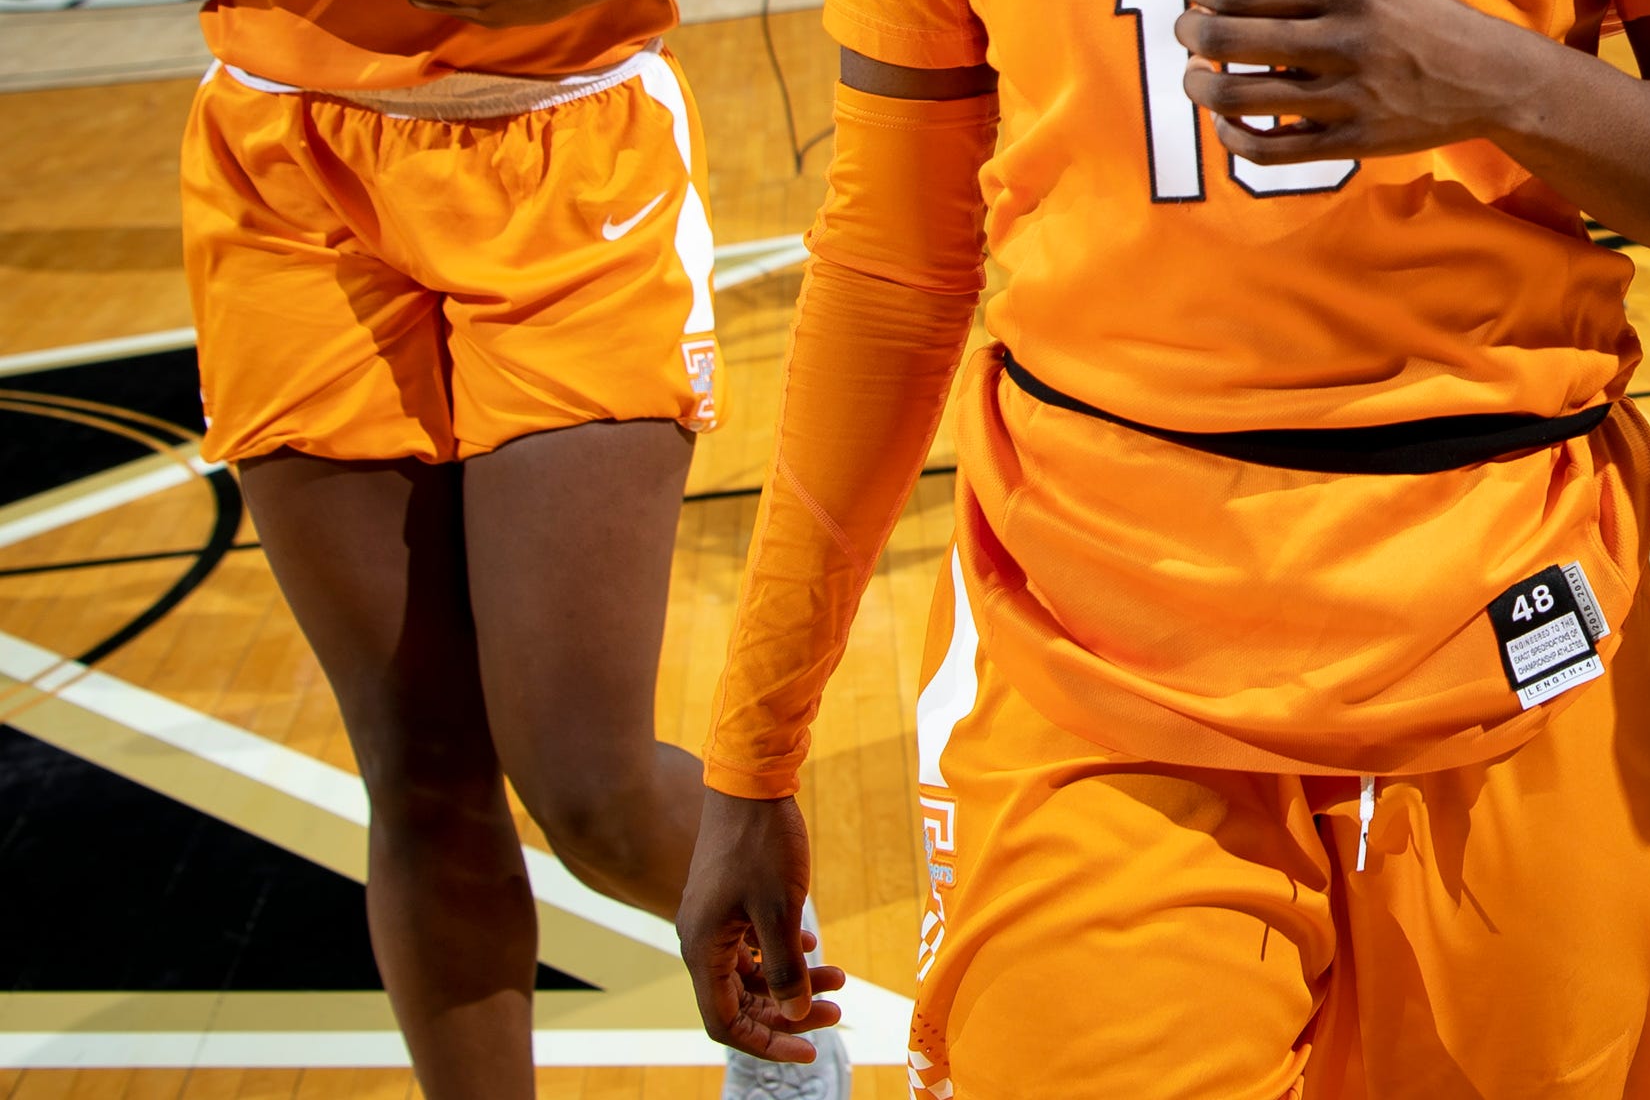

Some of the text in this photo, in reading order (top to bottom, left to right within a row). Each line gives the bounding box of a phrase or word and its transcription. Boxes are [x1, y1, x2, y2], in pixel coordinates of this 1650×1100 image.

[1511, 584, 1555, 622] 48
[1510, 629, 1550, 653] ENGINEERED
[1561, 617, 1576, 629] THE
[1513, 650, 1531, 665] EXACT
[1530, 632, 1571, 657] SPECIFICATIONS
[1518, 651, 1557, 675] CHAMPIONSHIP
